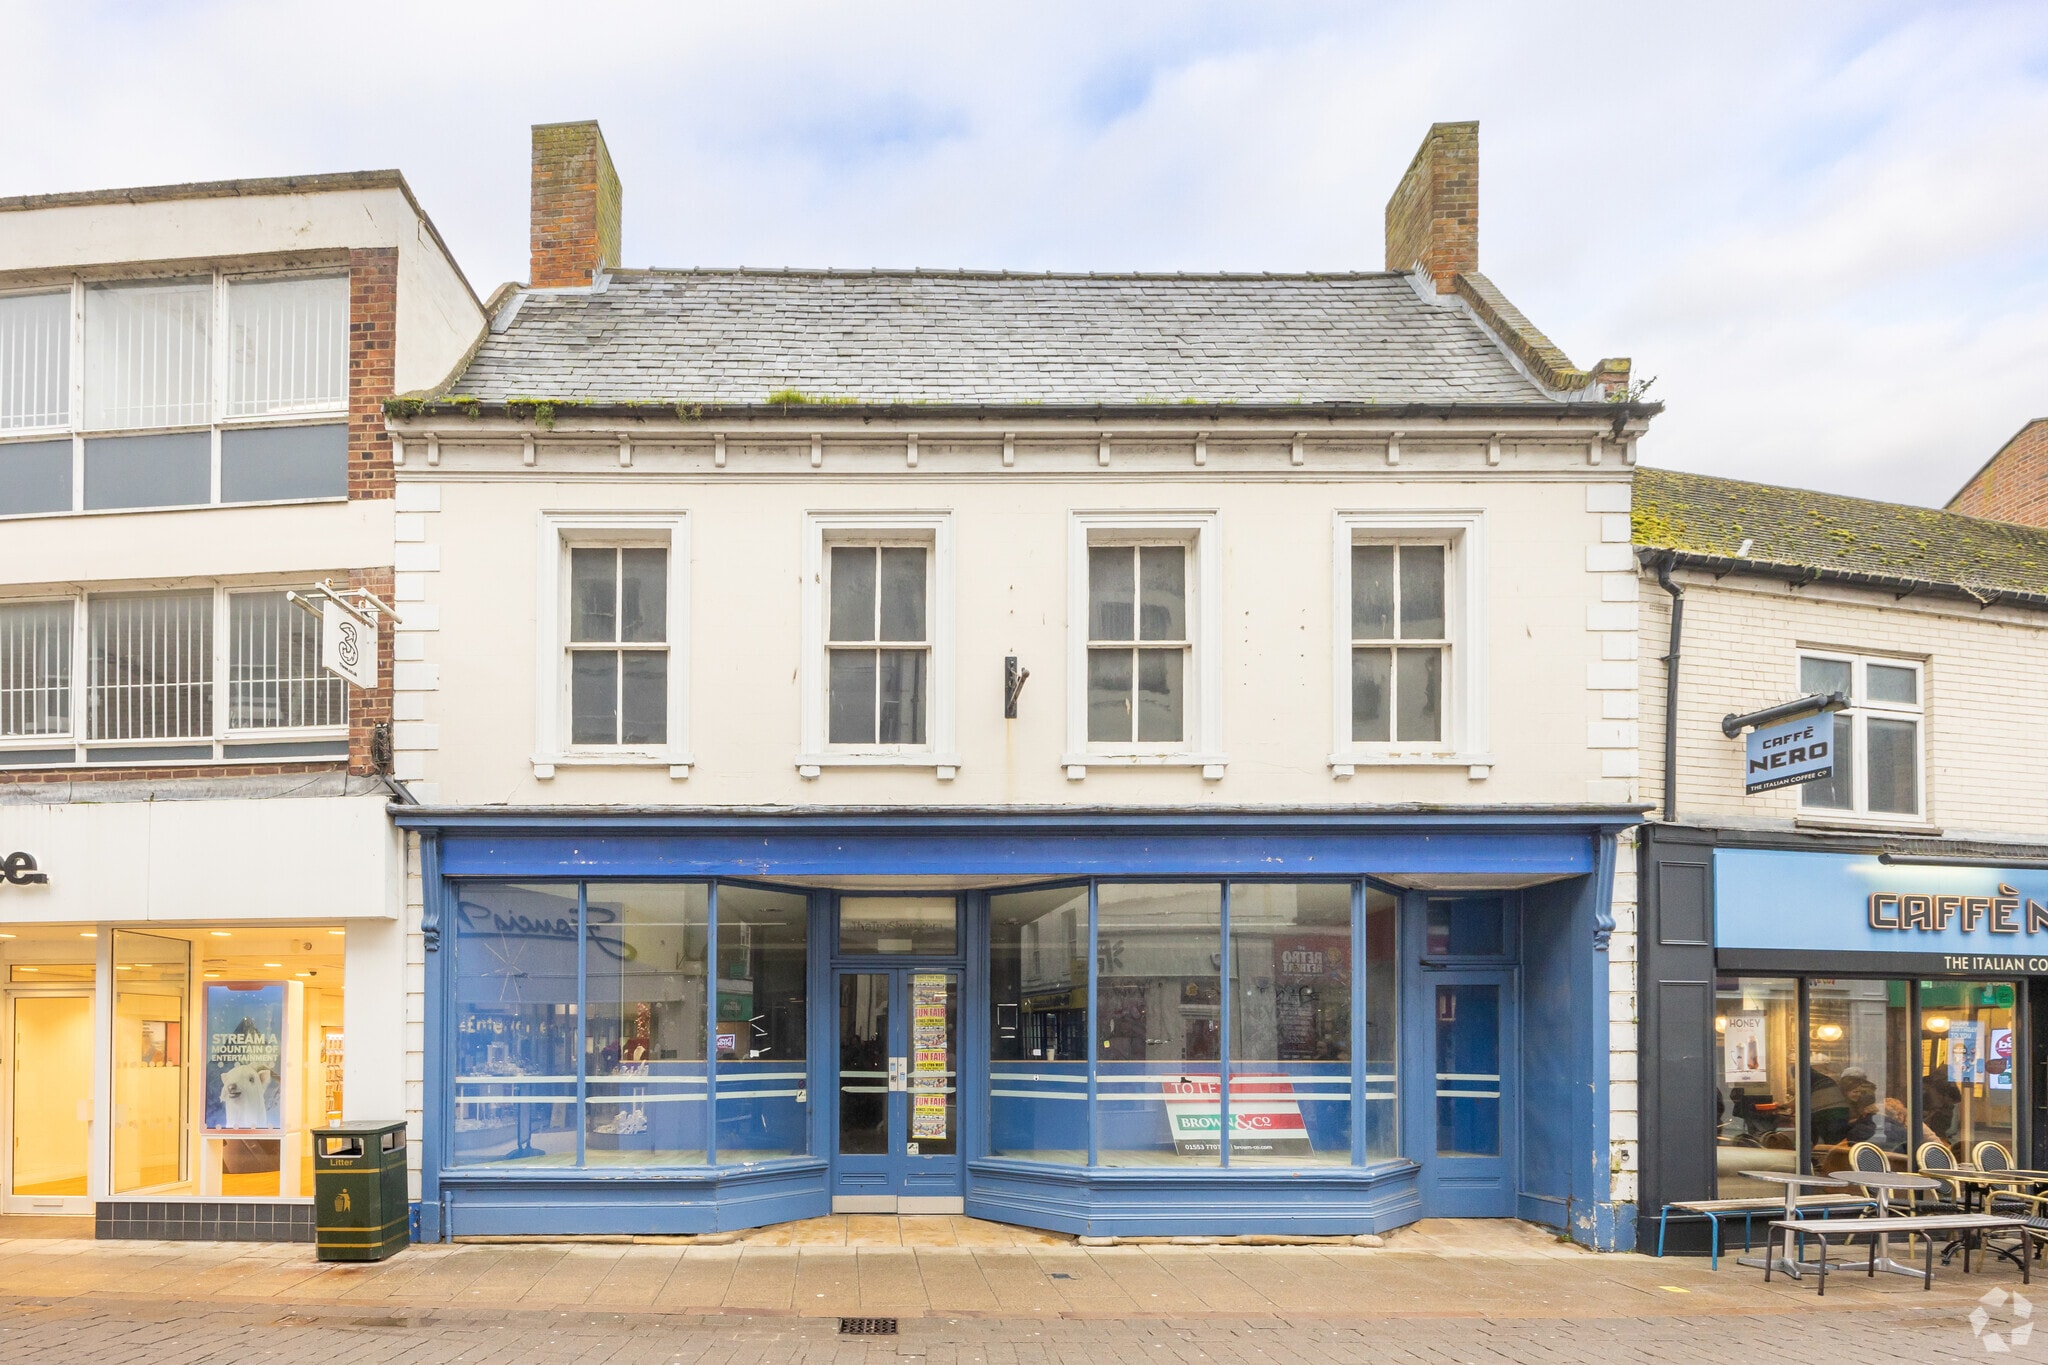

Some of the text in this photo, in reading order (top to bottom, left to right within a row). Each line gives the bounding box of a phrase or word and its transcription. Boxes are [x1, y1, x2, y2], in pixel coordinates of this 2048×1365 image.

[1749, 741, 1829, 774] NERO
[1763, 779, 1789, 788] ITALIAN
[1790, 773, 1816, 784] COFFEE
[1944, 956, 1969, 969] THE
[1973, 957, 2024, 971] ITALIAN
[915, 1008, 944, 1017] FUN FAIR
[1729, 1019, 1760, 1028] HONEY
[212, 1033, 278, 1044] STREAM A
[211, 1045, 279, 1054] MOUNTAIN OF
[211, 1054, 278, 1062] ENTERTAINMENT
[915, 1053, 944, 1062] FUN FAIR
[1171, 1083, 1194, 1094] TO
[915, 1098, 944, 1107] FUN FAIR
